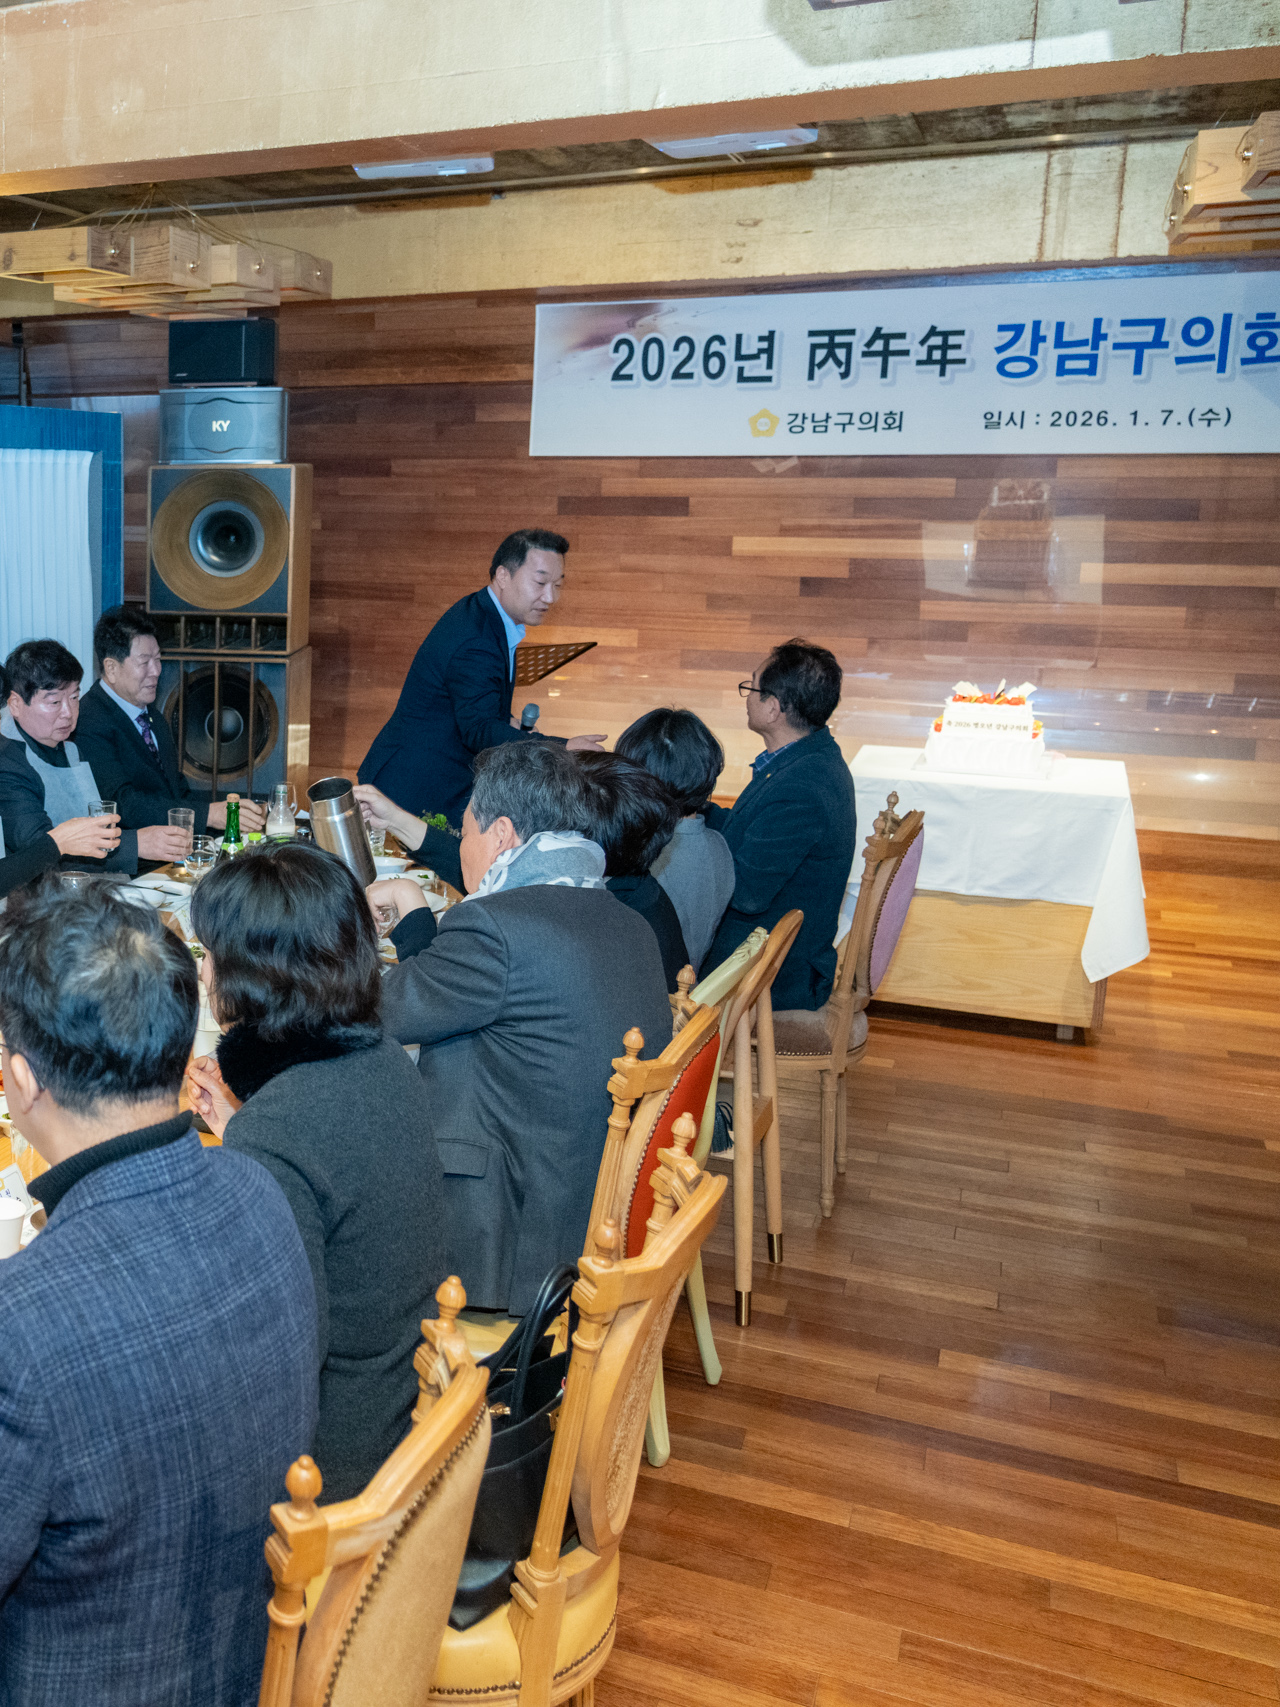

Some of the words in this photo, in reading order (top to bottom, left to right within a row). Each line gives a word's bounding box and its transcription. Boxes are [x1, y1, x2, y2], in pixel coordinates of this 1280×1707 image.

[611, 329, 776, 384] 2026년
[807, 325, 967, 382] 丙午年
[212, 420, 231, 432] KY
[787, 410, 904, 435] 강남구의회
[983, 410, 1025, 430] 일시
[1050, 410, 1118, 428] 2026.
